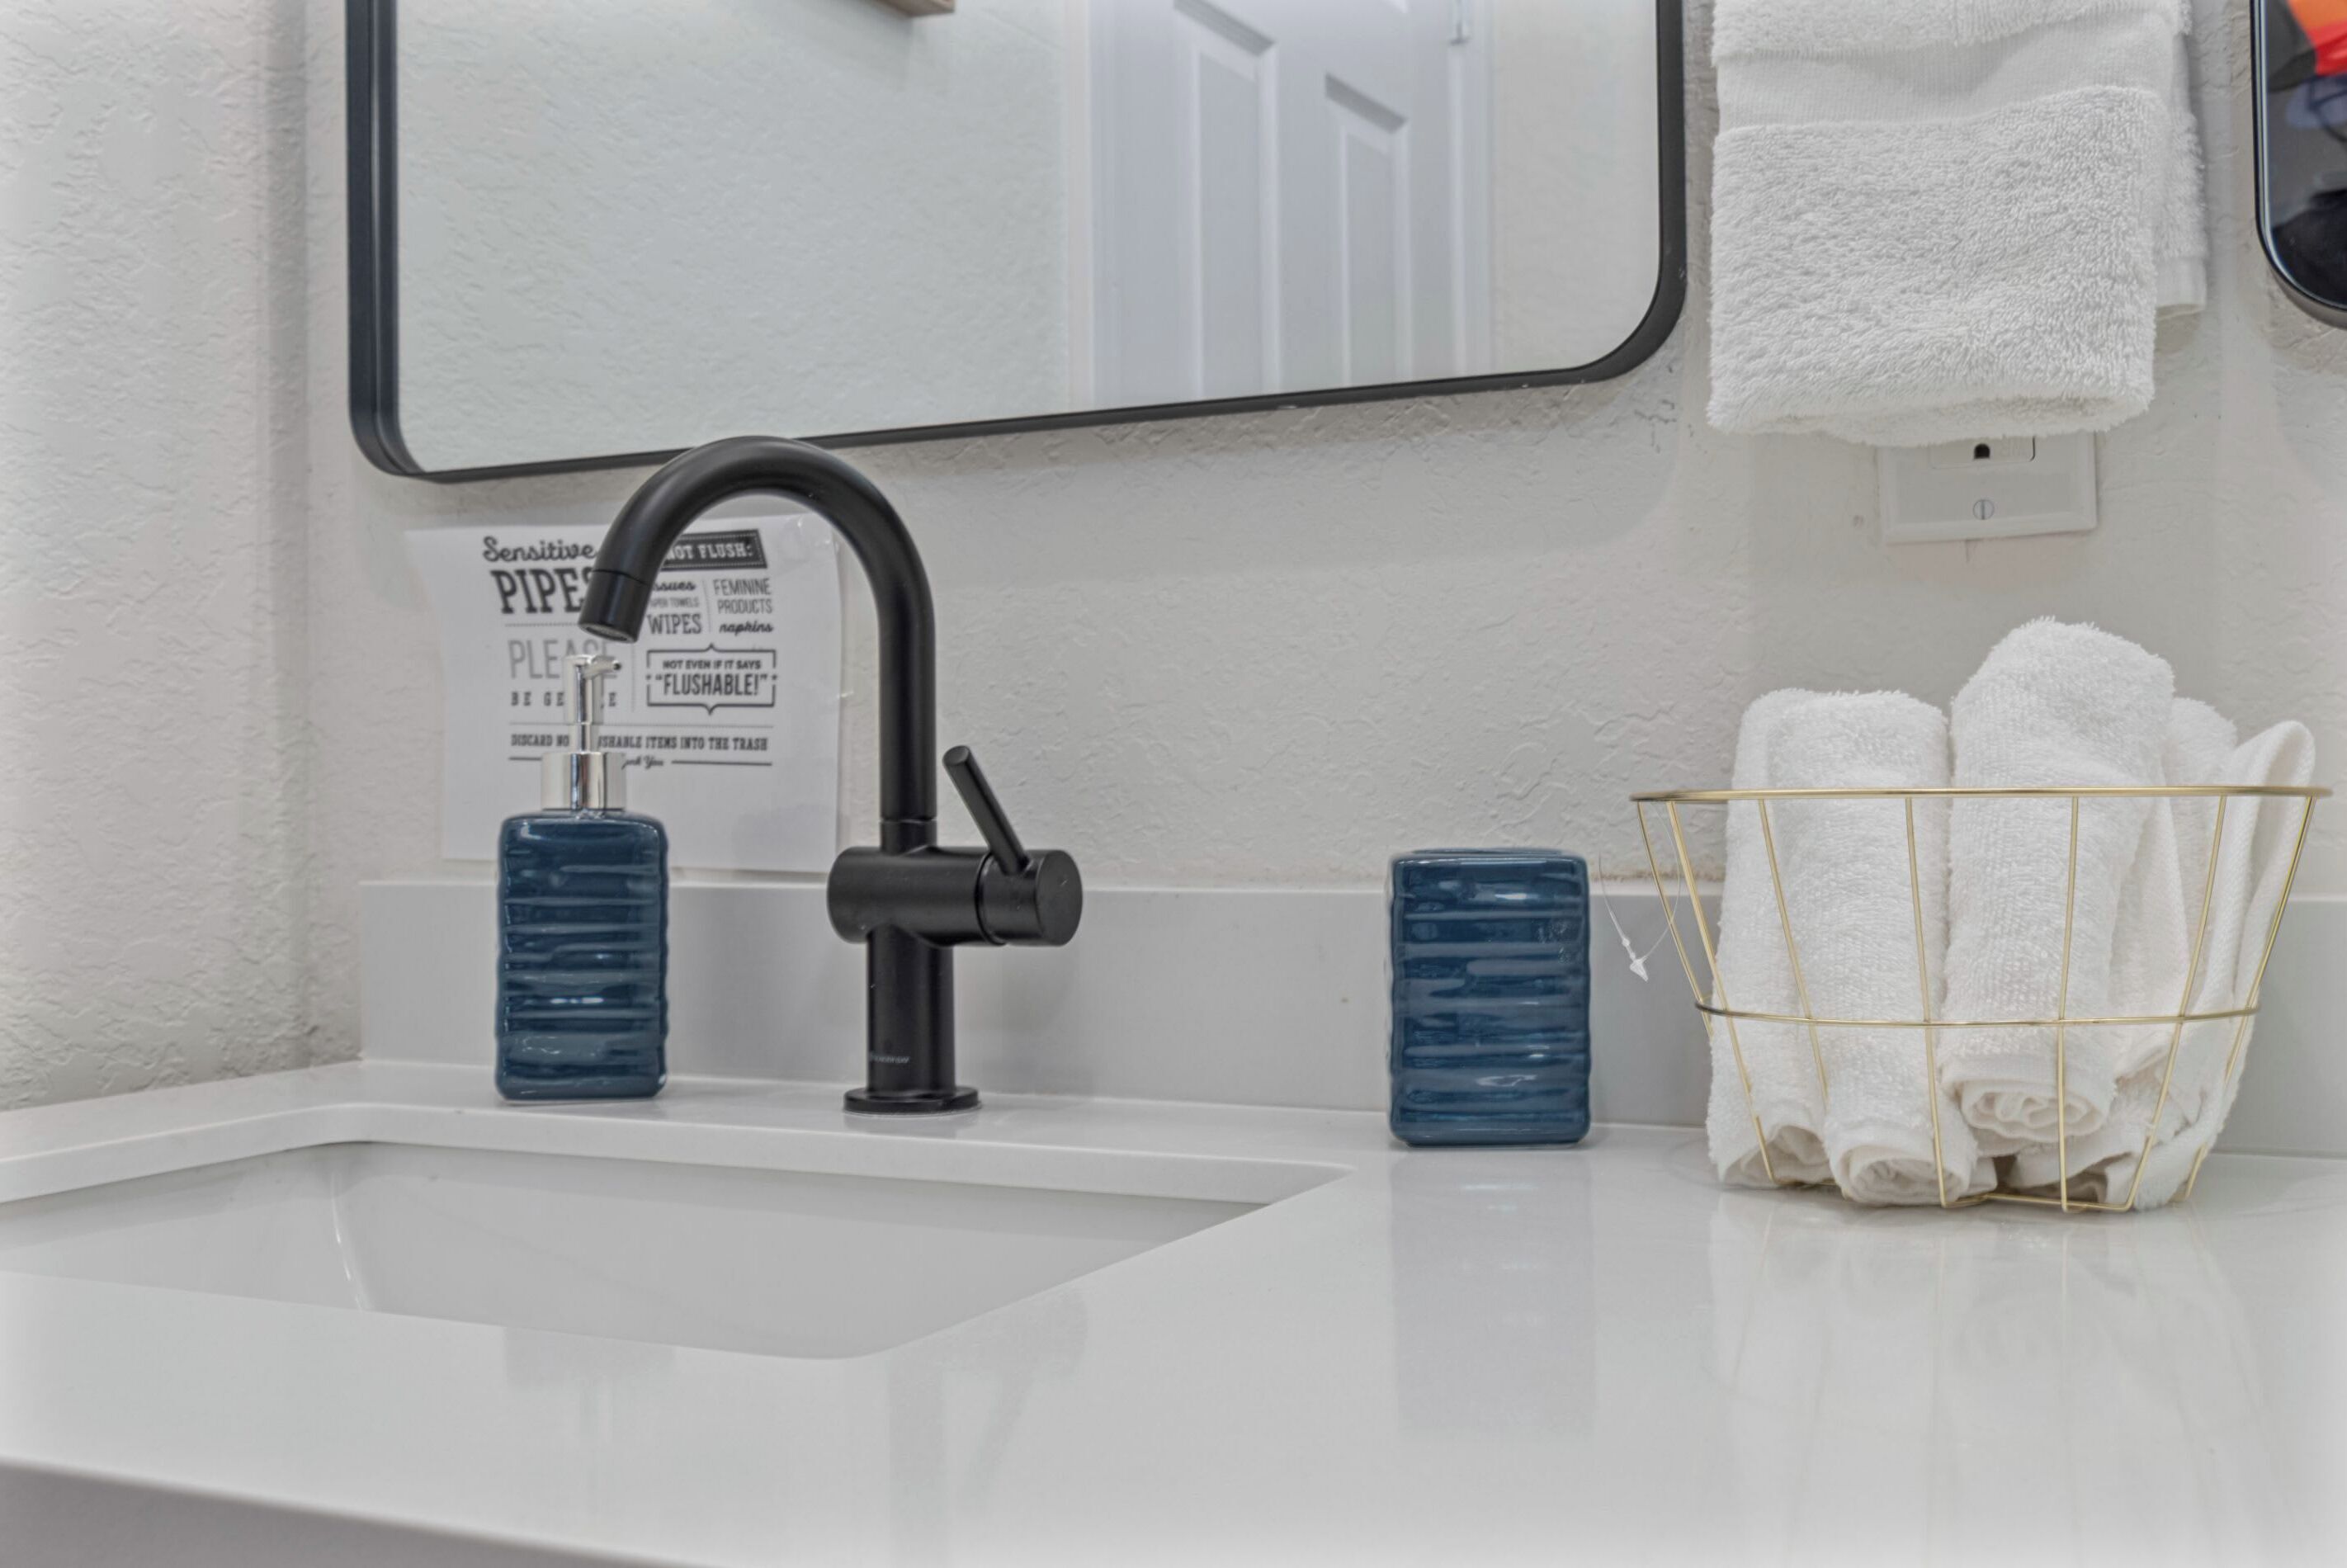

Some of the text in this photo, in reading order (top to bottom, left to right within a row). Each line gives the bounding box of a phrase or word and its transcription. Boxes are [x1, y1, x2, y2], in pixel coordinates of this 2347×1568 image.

[483, 536, 600, 562] Sensitive
[698, 541, 754, 559] FLUSH:
[713, 578, 772, 596] FEMININE
[670, 597, 700, 608] TOWELS
[717, 598, 772, 615] PRODUCTS
[647, 613, 701, 635] WIPES
[719, 621, 774, 636] napkins
[663, 659, 761, 669] NOT EVEN IF IT SAYS
[511, 692, 531, 706] BE
[511, 734, 553, 747] DISCARD
[645, 736, 678, 749] ITEMS
[680, 737, 705, 750] INTO
[708, 737, 729, 750] THE
[732, 737, 768, 751] TRASH
